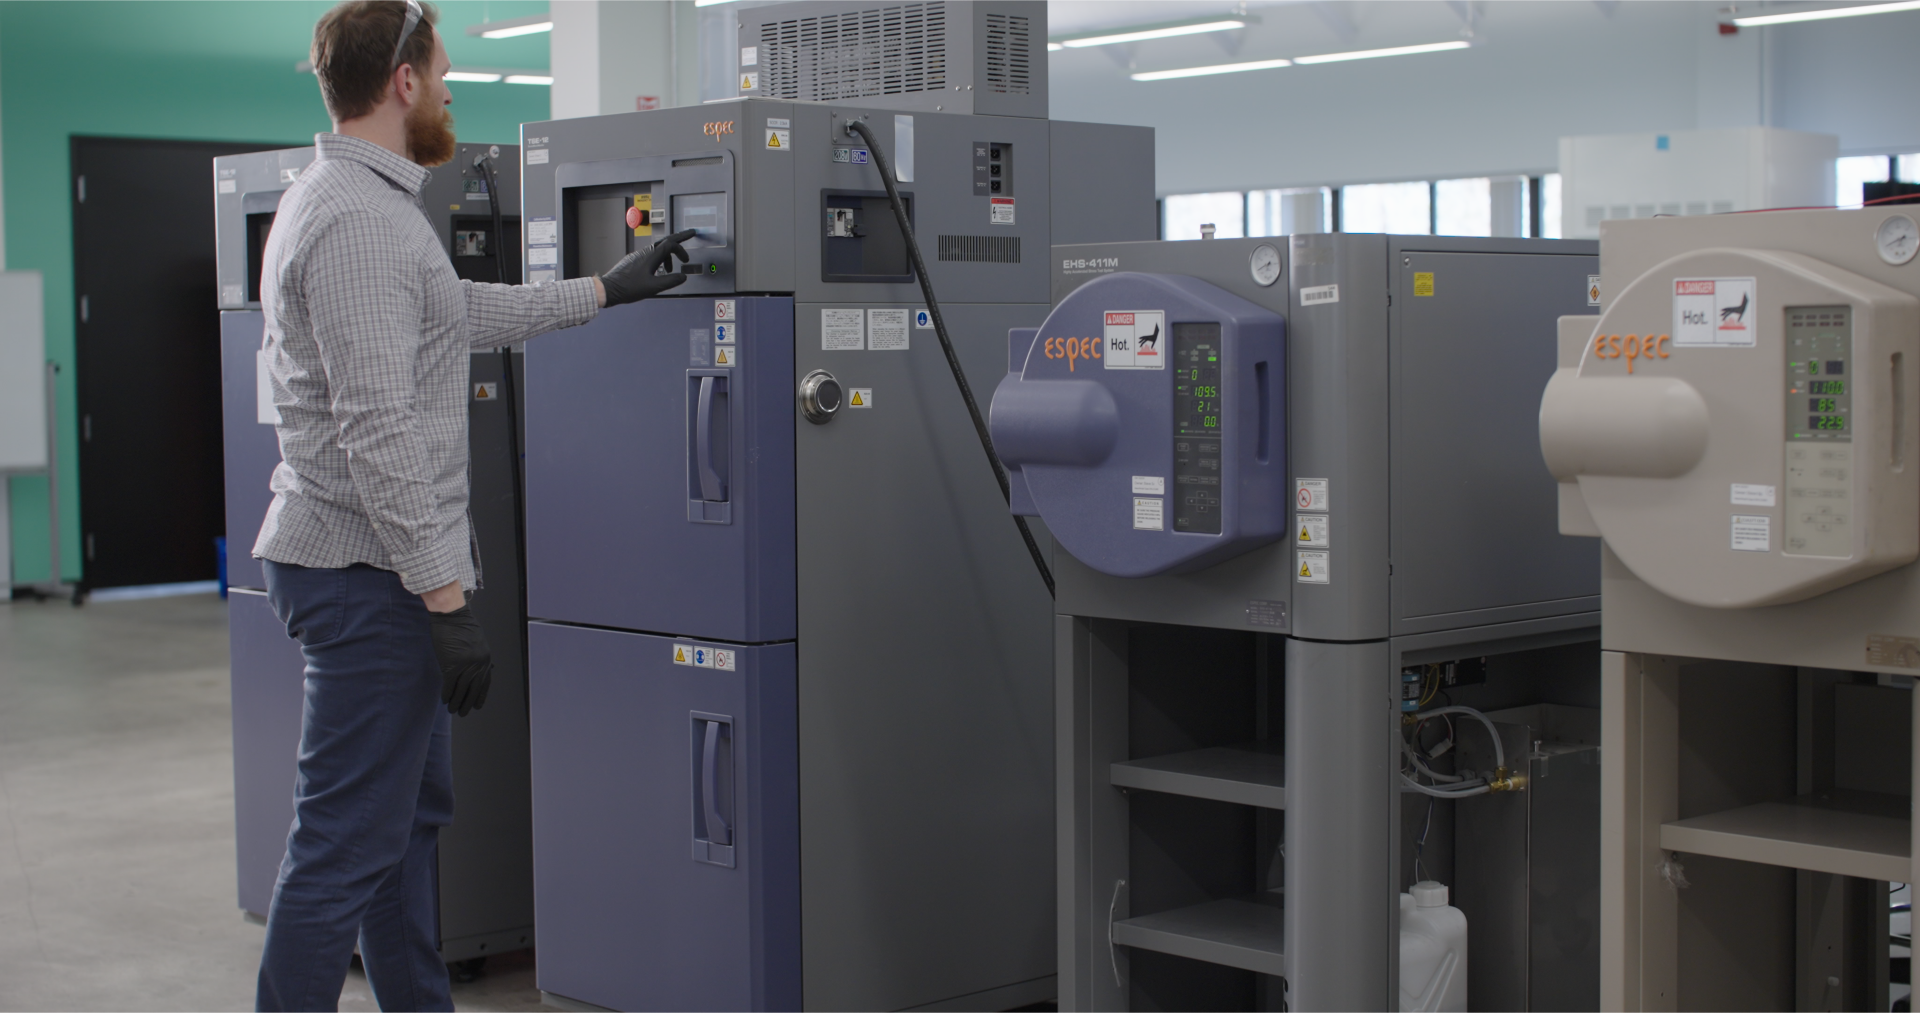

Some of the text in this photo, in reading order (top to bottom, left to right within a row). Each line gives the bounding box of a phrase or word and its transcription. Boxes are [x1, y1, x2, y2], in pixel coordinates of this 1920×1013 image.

[1682, 281, 1714, 294] DANGER
[1112, 314, 1134, 324] DANGER
[1111, 338, 1130, 350] Hot.
[1810, 361, 1818, 374] 0
[1192, 370, 1198, 380] 0
[1198, 401, 1210, 412] 21
[1818, 399, 1835, 412] 85
